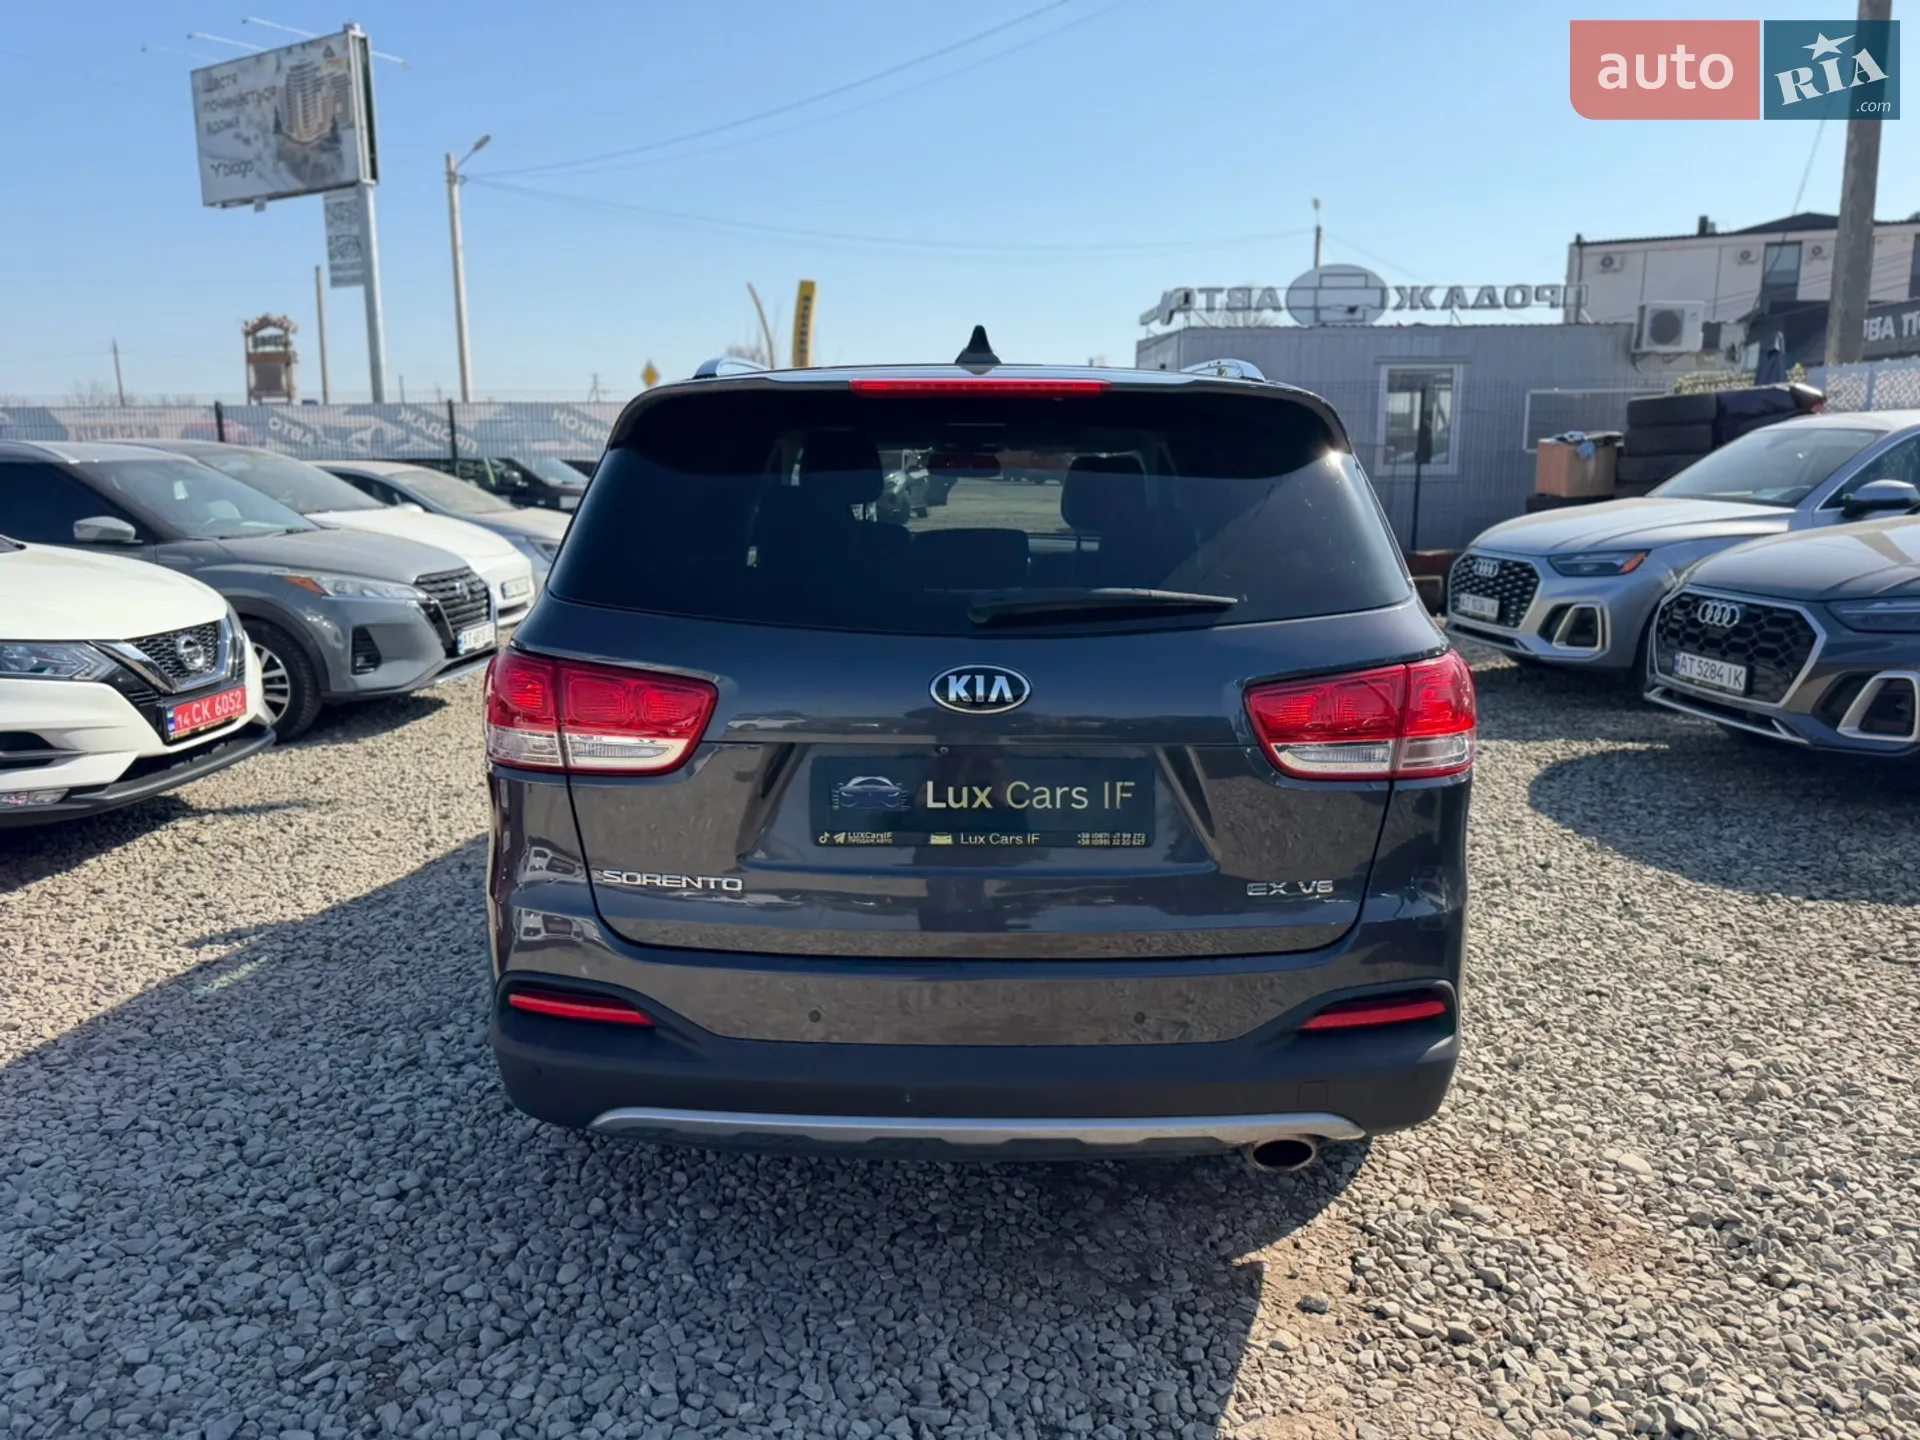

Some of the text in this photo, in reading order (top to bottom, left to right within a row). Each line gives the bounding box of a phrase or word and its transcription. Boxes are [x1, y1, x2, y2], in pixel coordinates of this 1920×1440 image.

[1863, 316, 1896, 342] ВА
[1681, 655, 1744, 688] AT 5284 IK
[947, 674, 1014, 702] KIA
[191, 703, 213, 723] CK
[214, 691, 242, 717] 6052
[926, 780, 1136, 810] Lux Cars IF
[960, 833, 1040, 845] Lux Cars IF
[602, 870, 743, 891] SORENTO
[1246, 880, 1334, 896] EX V6
